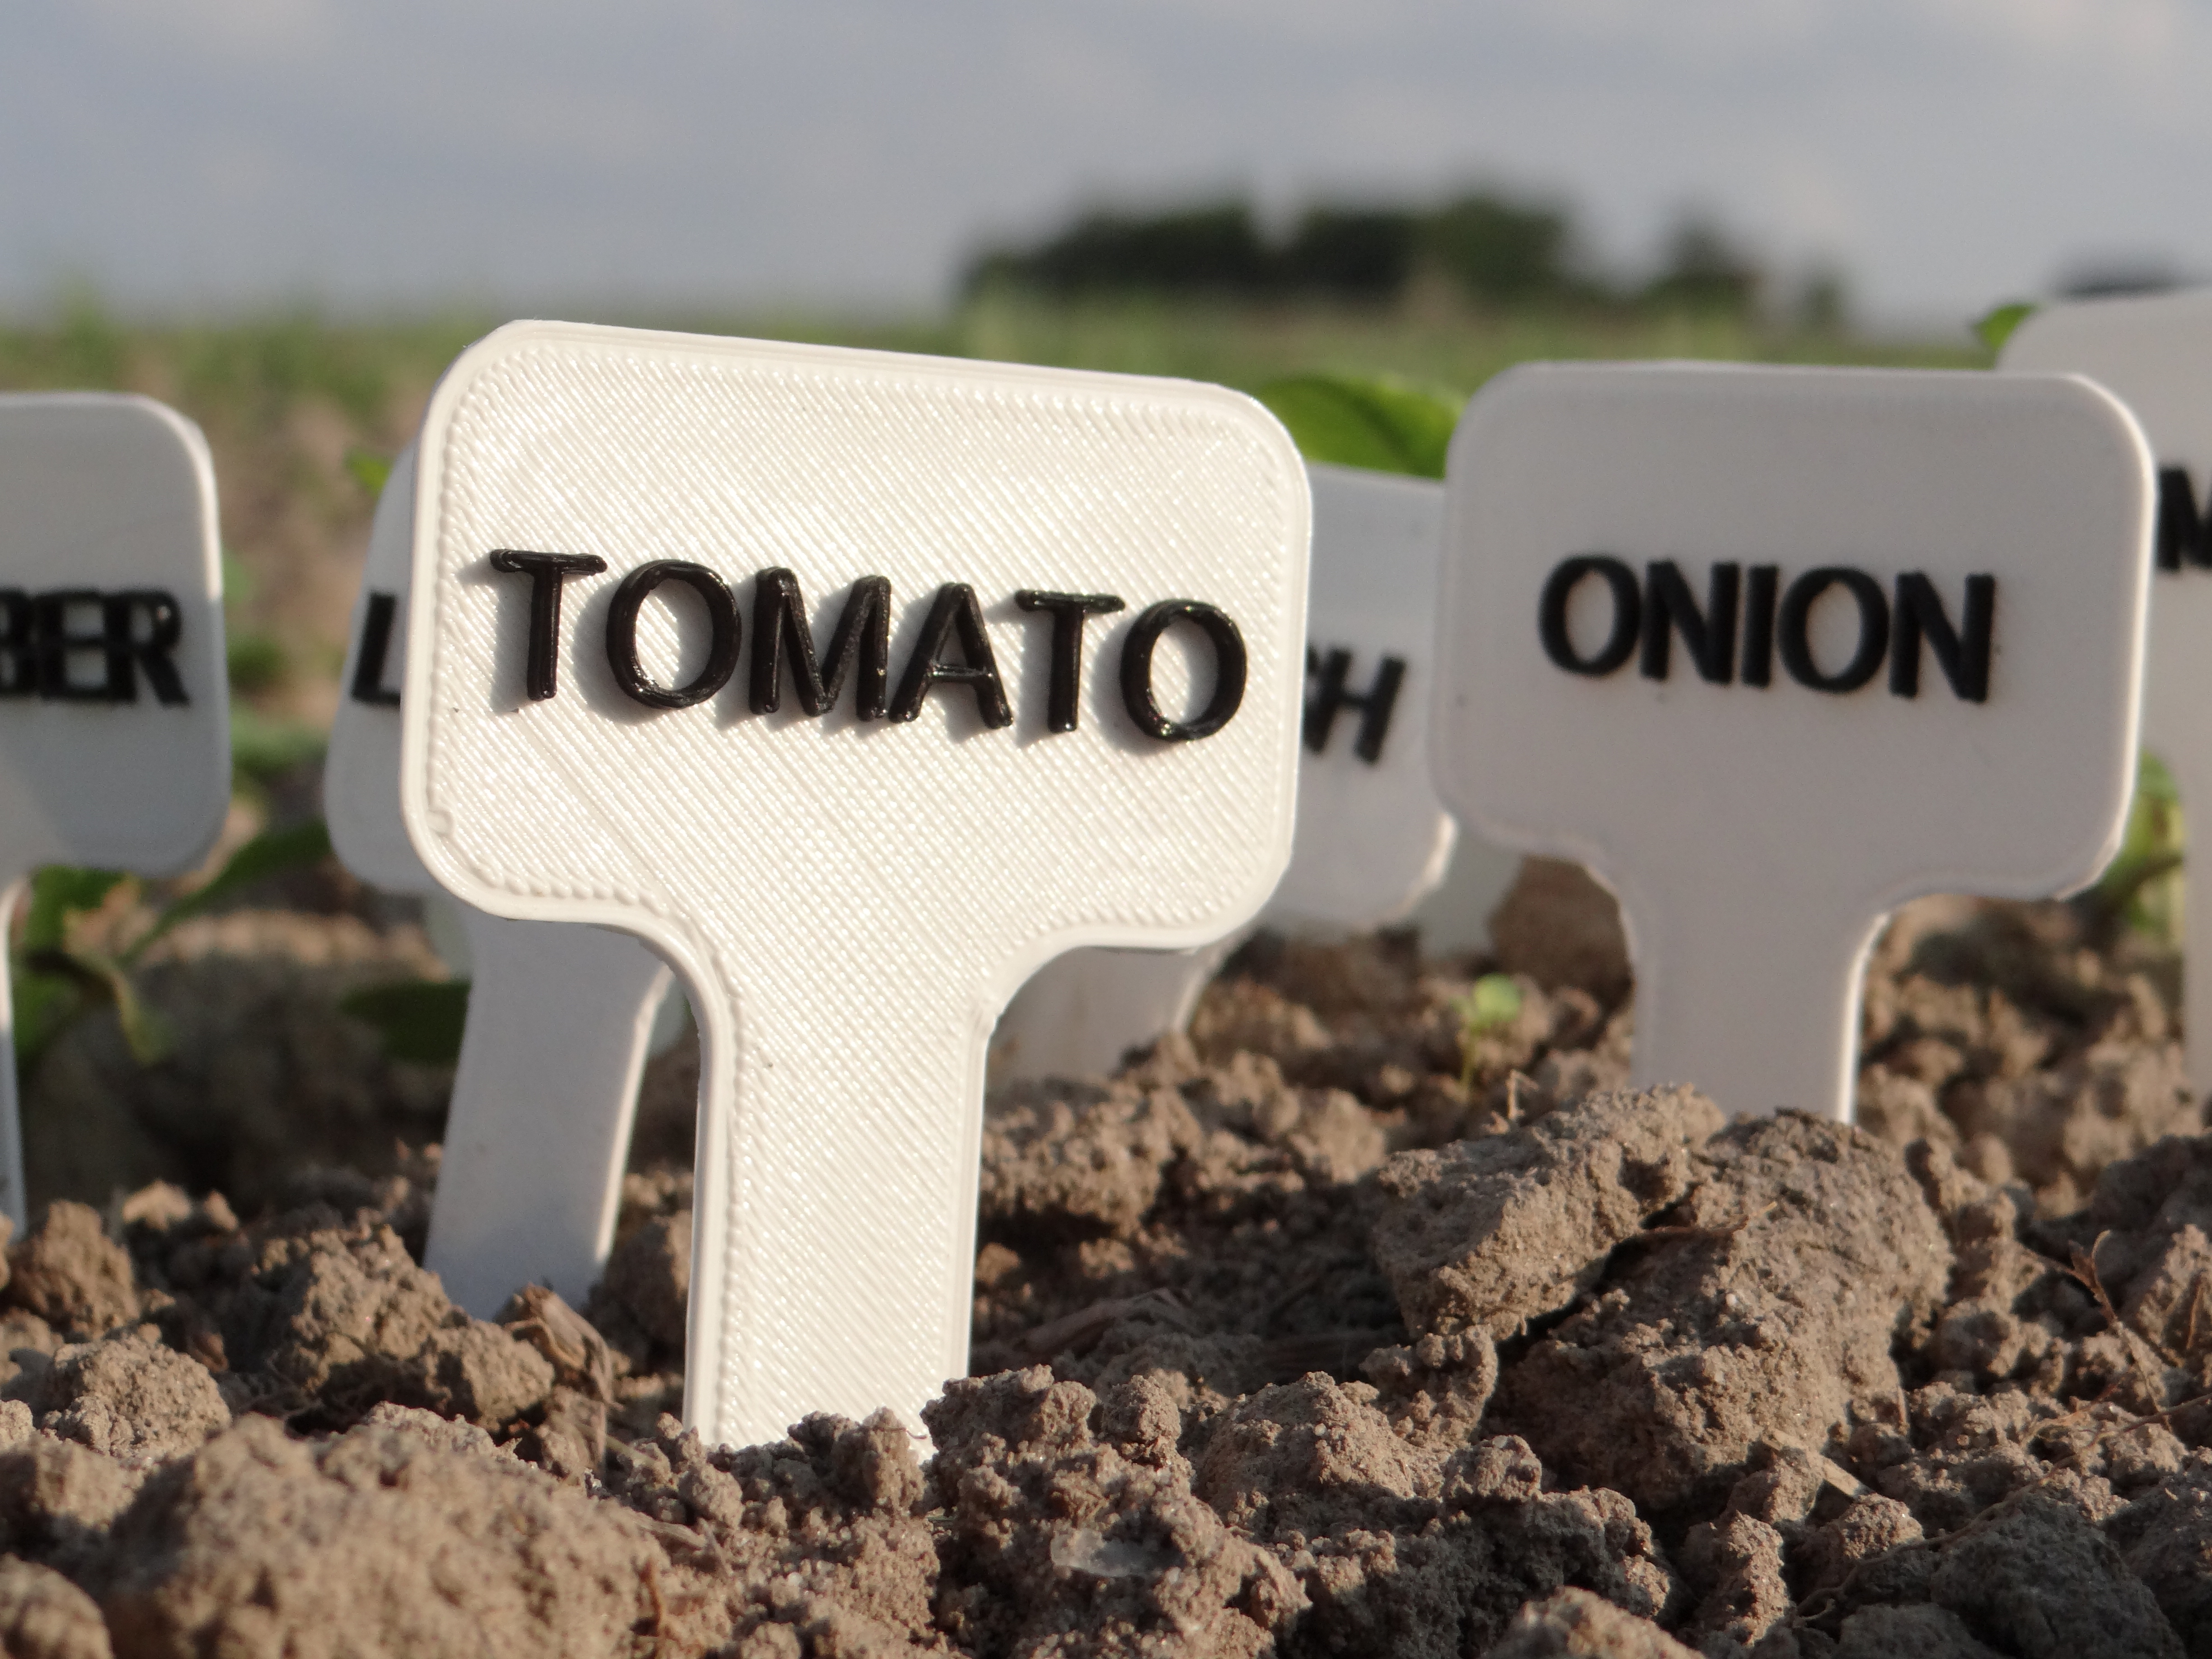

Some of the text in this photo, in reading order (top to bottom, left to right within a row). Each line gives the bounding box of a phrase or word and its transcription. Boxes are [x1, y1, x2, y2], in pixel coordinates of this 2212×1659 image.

[489, 548, 1248, 741] TOMATO
[1303, 642, 1406, 764] H
[1538, 554, 1996, 703] ONION
